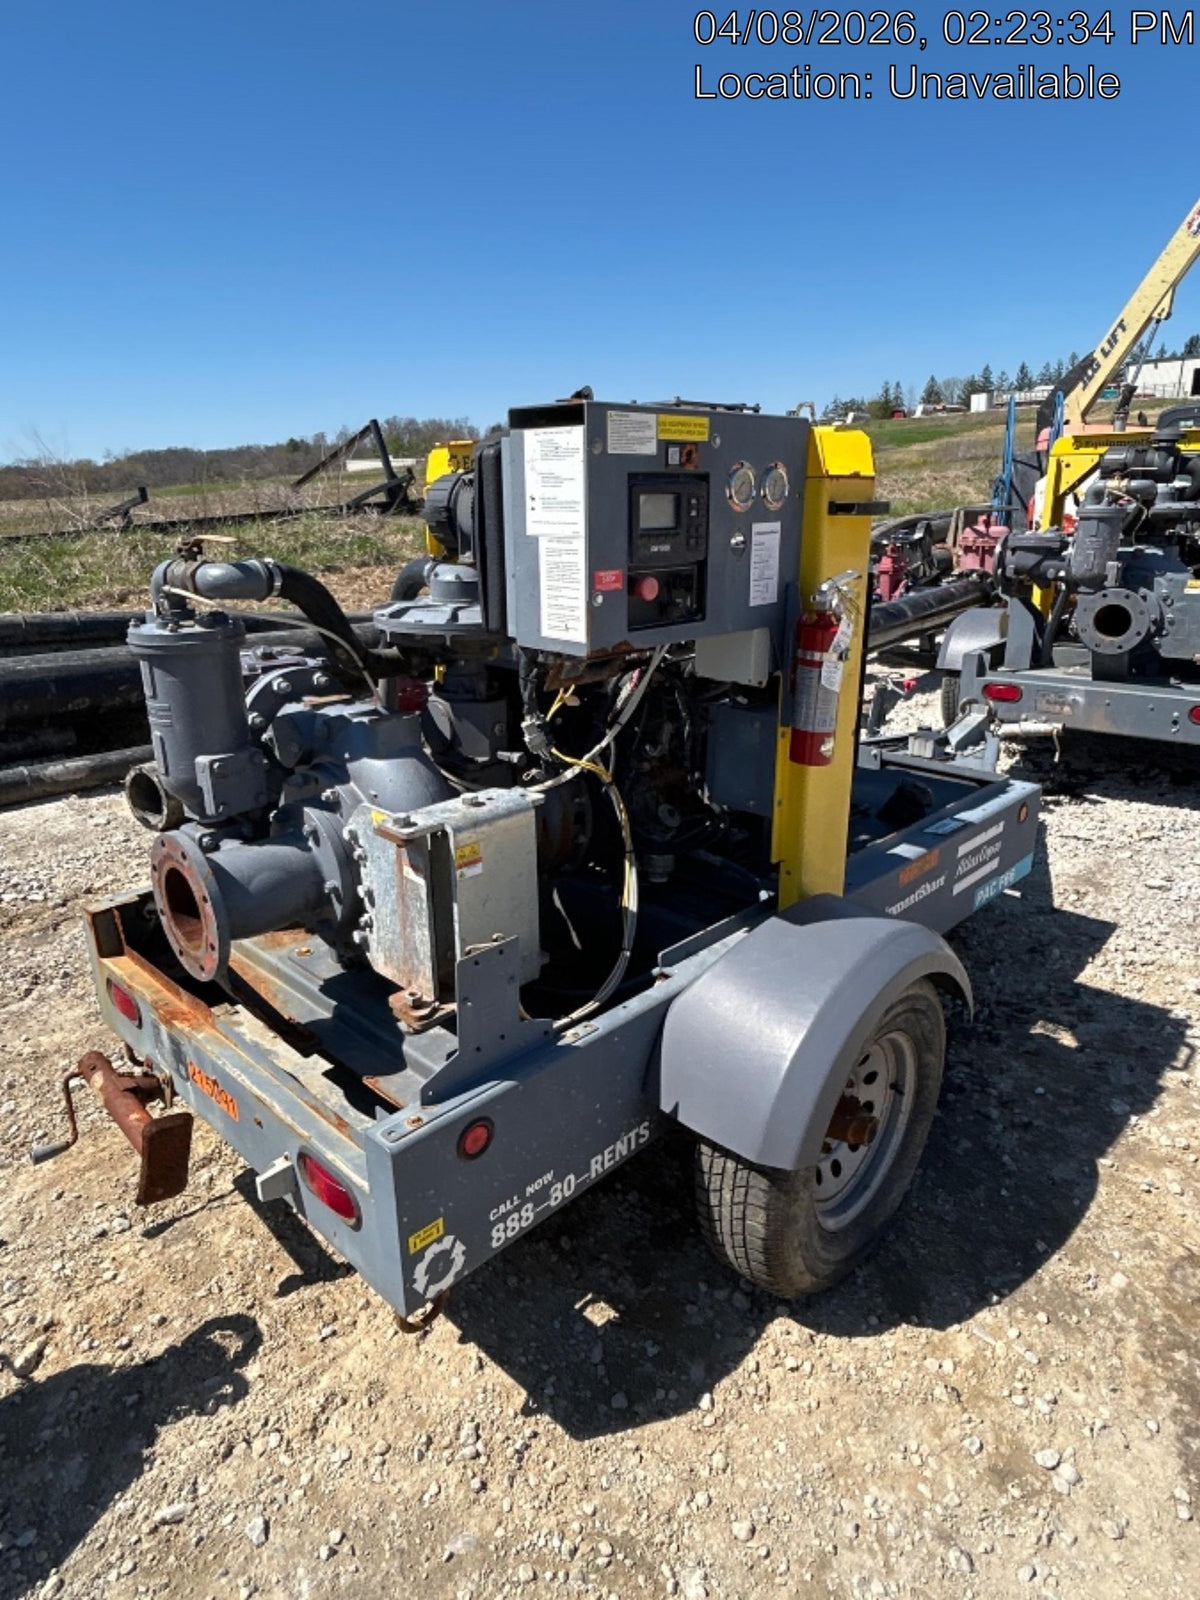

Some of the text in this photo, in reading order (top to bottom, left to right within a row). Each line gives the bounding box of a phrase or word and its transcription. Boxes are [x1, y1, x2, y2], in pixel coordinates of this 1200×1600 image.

[1101, 318, 1126, 358] LIFT
[490, 1169, 554, 1221] CALL NOW
